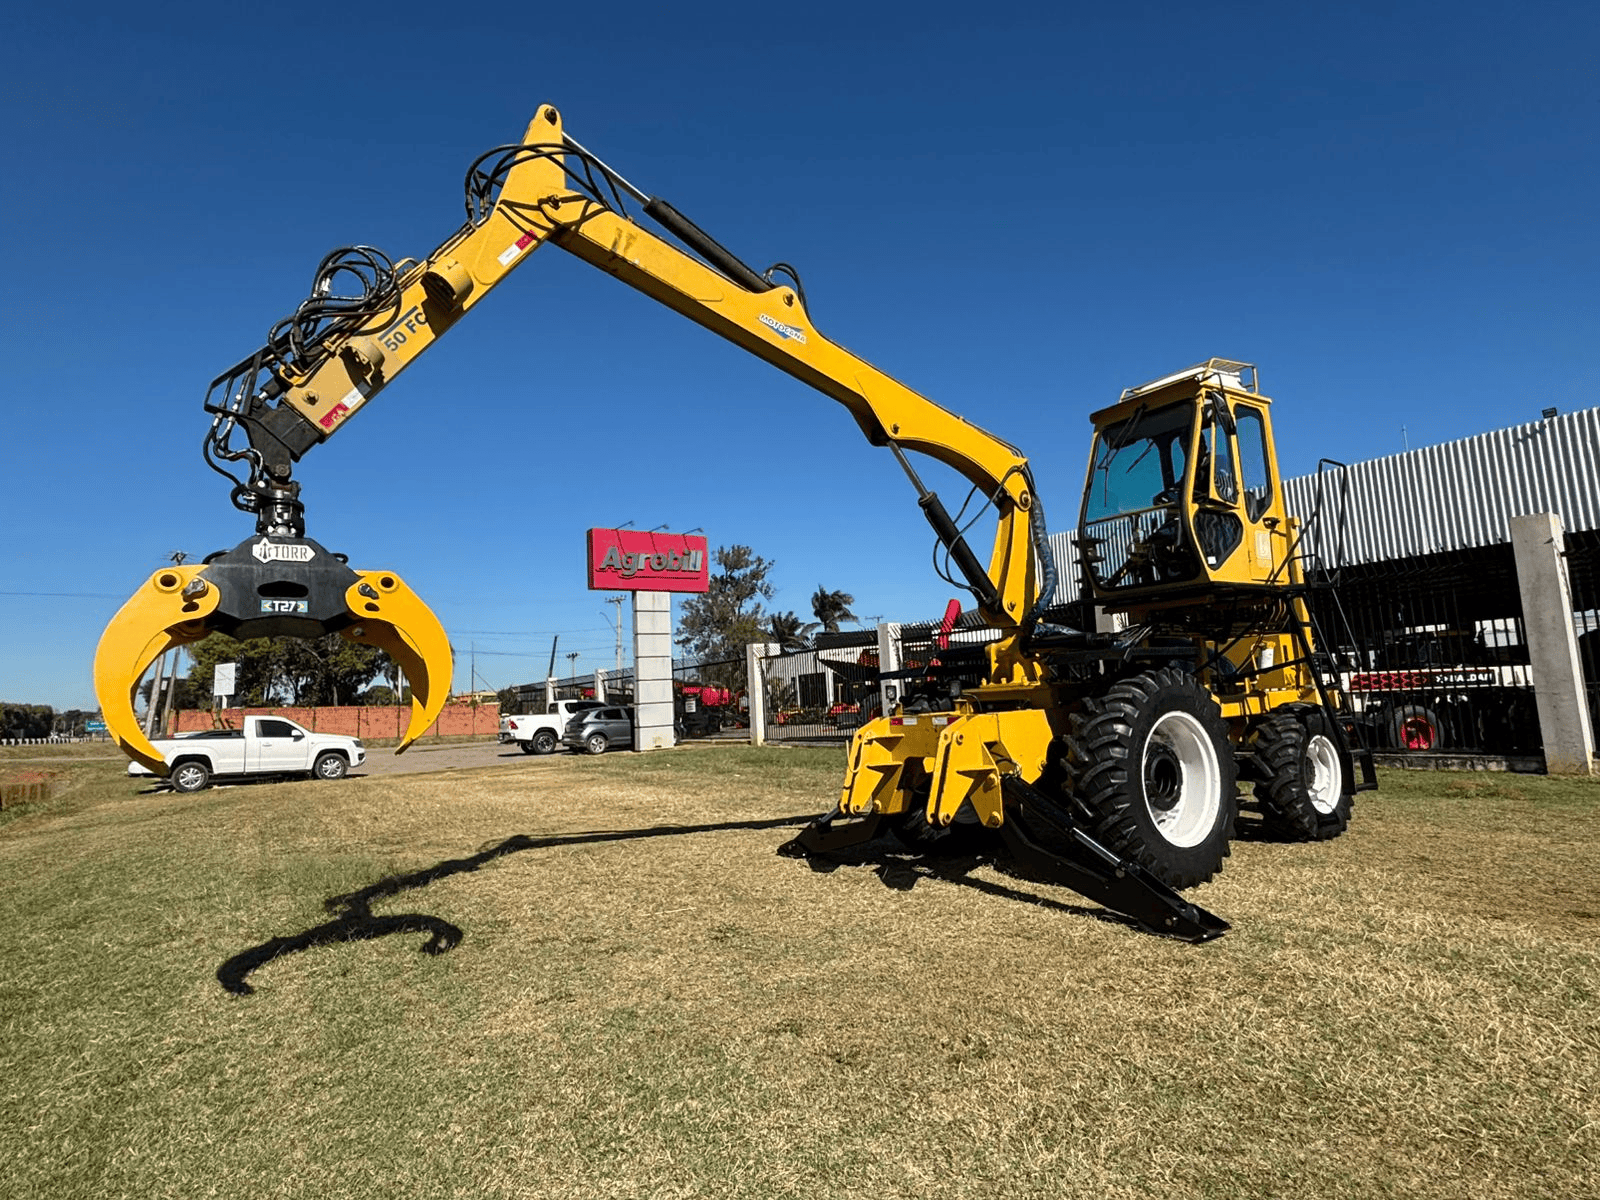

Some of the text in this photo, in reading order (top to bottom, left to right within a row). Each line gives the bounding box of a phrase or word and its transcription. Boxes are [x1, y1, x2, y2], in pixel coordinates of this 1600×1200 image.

[384, 331, 407, 351] 50
[599, 545, 703, 577] Agrobill
[272, 600, 297, 612] T27
